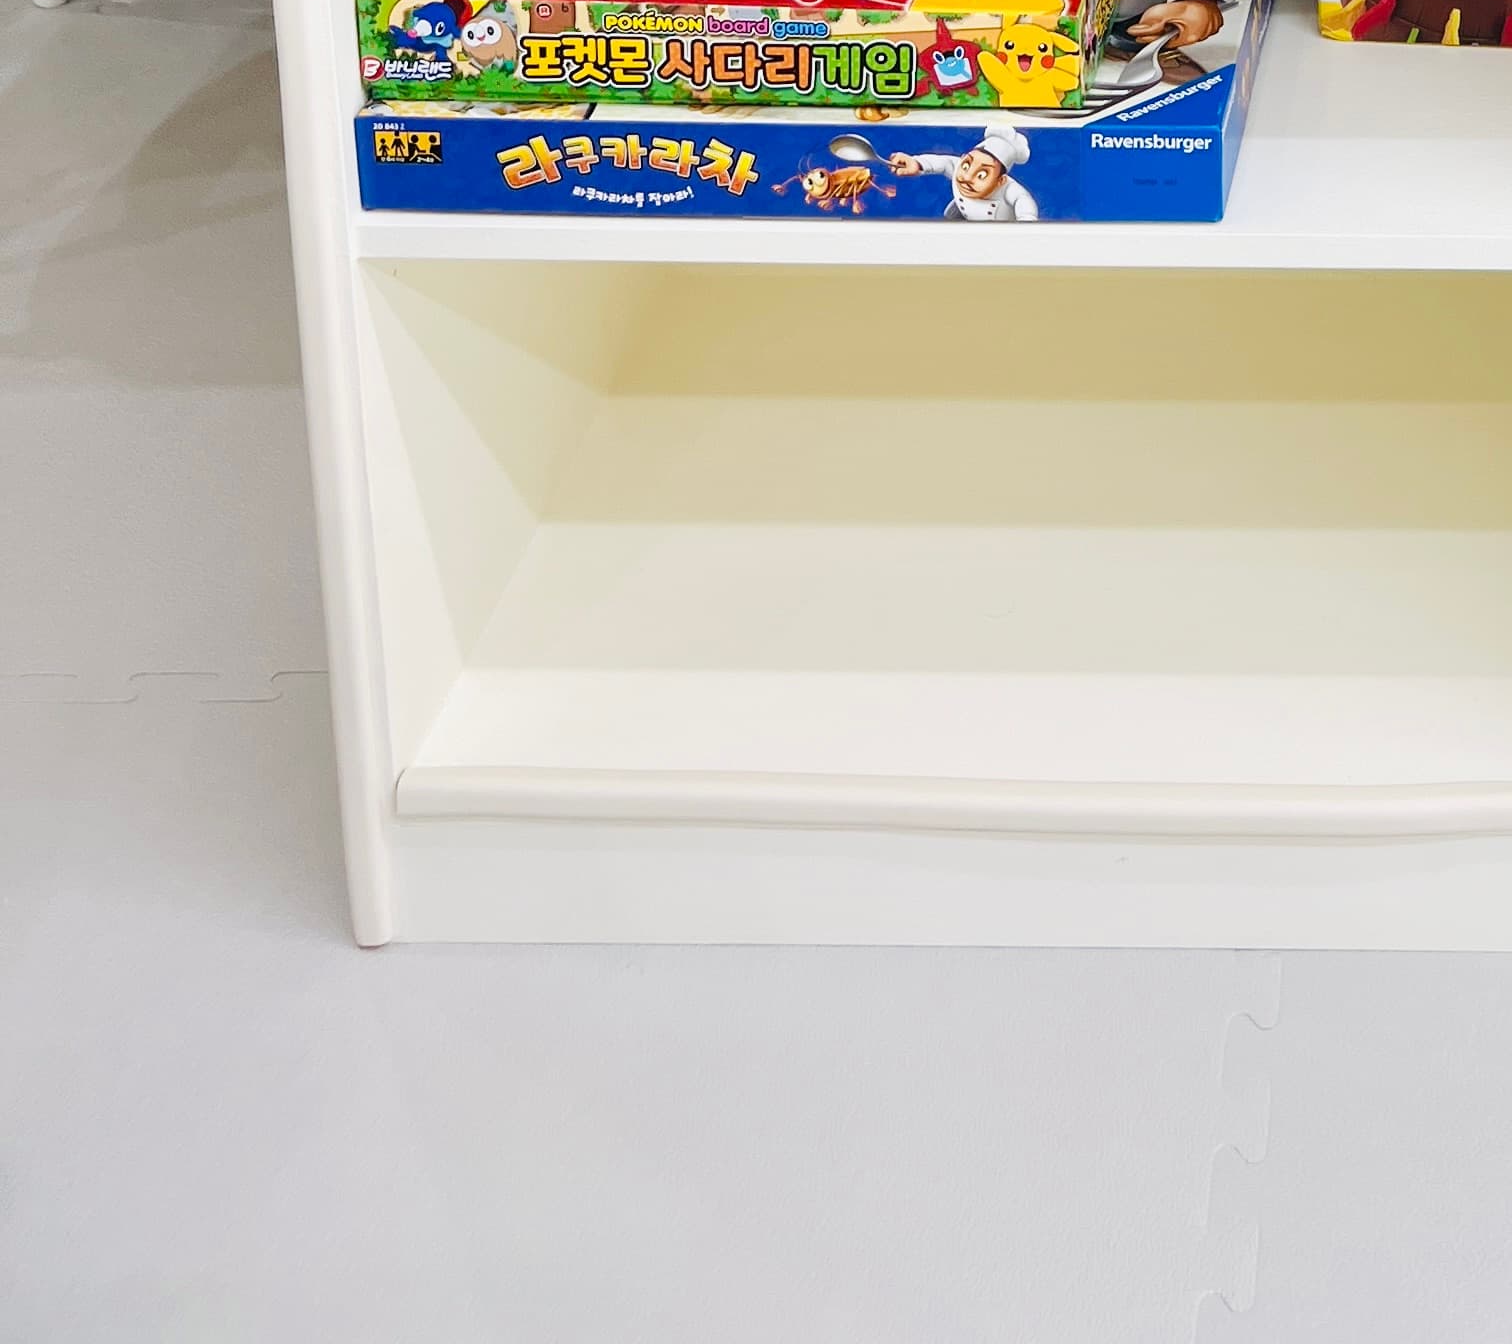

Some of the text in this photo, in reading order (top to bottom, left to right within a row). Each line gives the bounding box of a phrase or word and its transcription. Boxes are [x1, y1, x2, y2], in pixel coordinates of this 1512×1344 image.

[605, 13, 828, 38] POKÉMON board game
[522, 35, 916, 95] 포켓몬 사다리게임
[1116, 71, 1225, 124] Ravensburger
[496, 134, 760, 197] 라쿠카라차
[1090, 132, 1213, 154] Ravensburger
